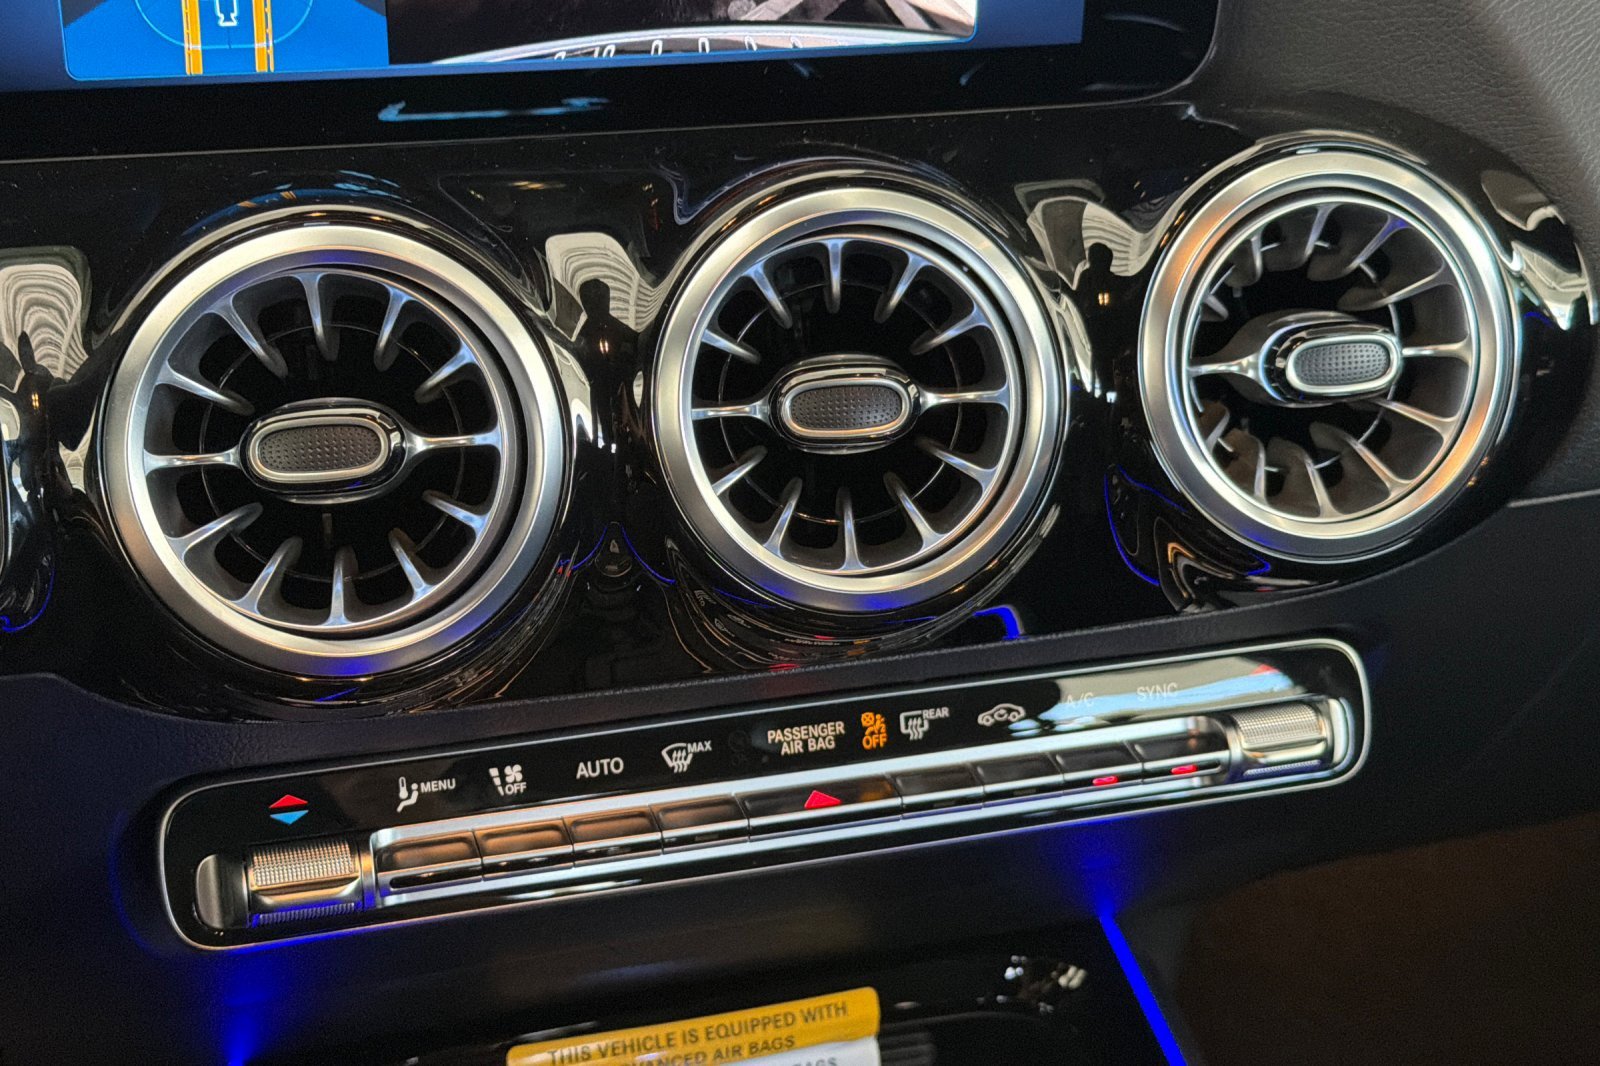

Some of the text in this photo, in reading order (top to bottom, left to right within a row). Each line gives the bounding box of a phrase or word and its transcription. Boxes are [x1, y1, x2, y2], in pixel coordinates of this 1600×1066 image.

[1066, 692, 1094, 708] A/C
[1137, 682, 1178, 701] SYNC
[922, 707, 949, 720] REAR
[767, 721, 845, 744] PASSENGER
[862, 733, 888, 750] OFF
[687, 740, 712, 754] MAX
[781, 735, 836, 756] AIR BAG
[576, 757, 624, 779] AUTO
[420, 778, 456, 794] MENU
[505, 782, 527, 795] OFF
[548, 1001, 847, 1066] THIS VEHICLE IS EQUIPPED WITH
[713, 1045, 742, 1061] AIR
[748, 1034, 796, 1056] BAGS
